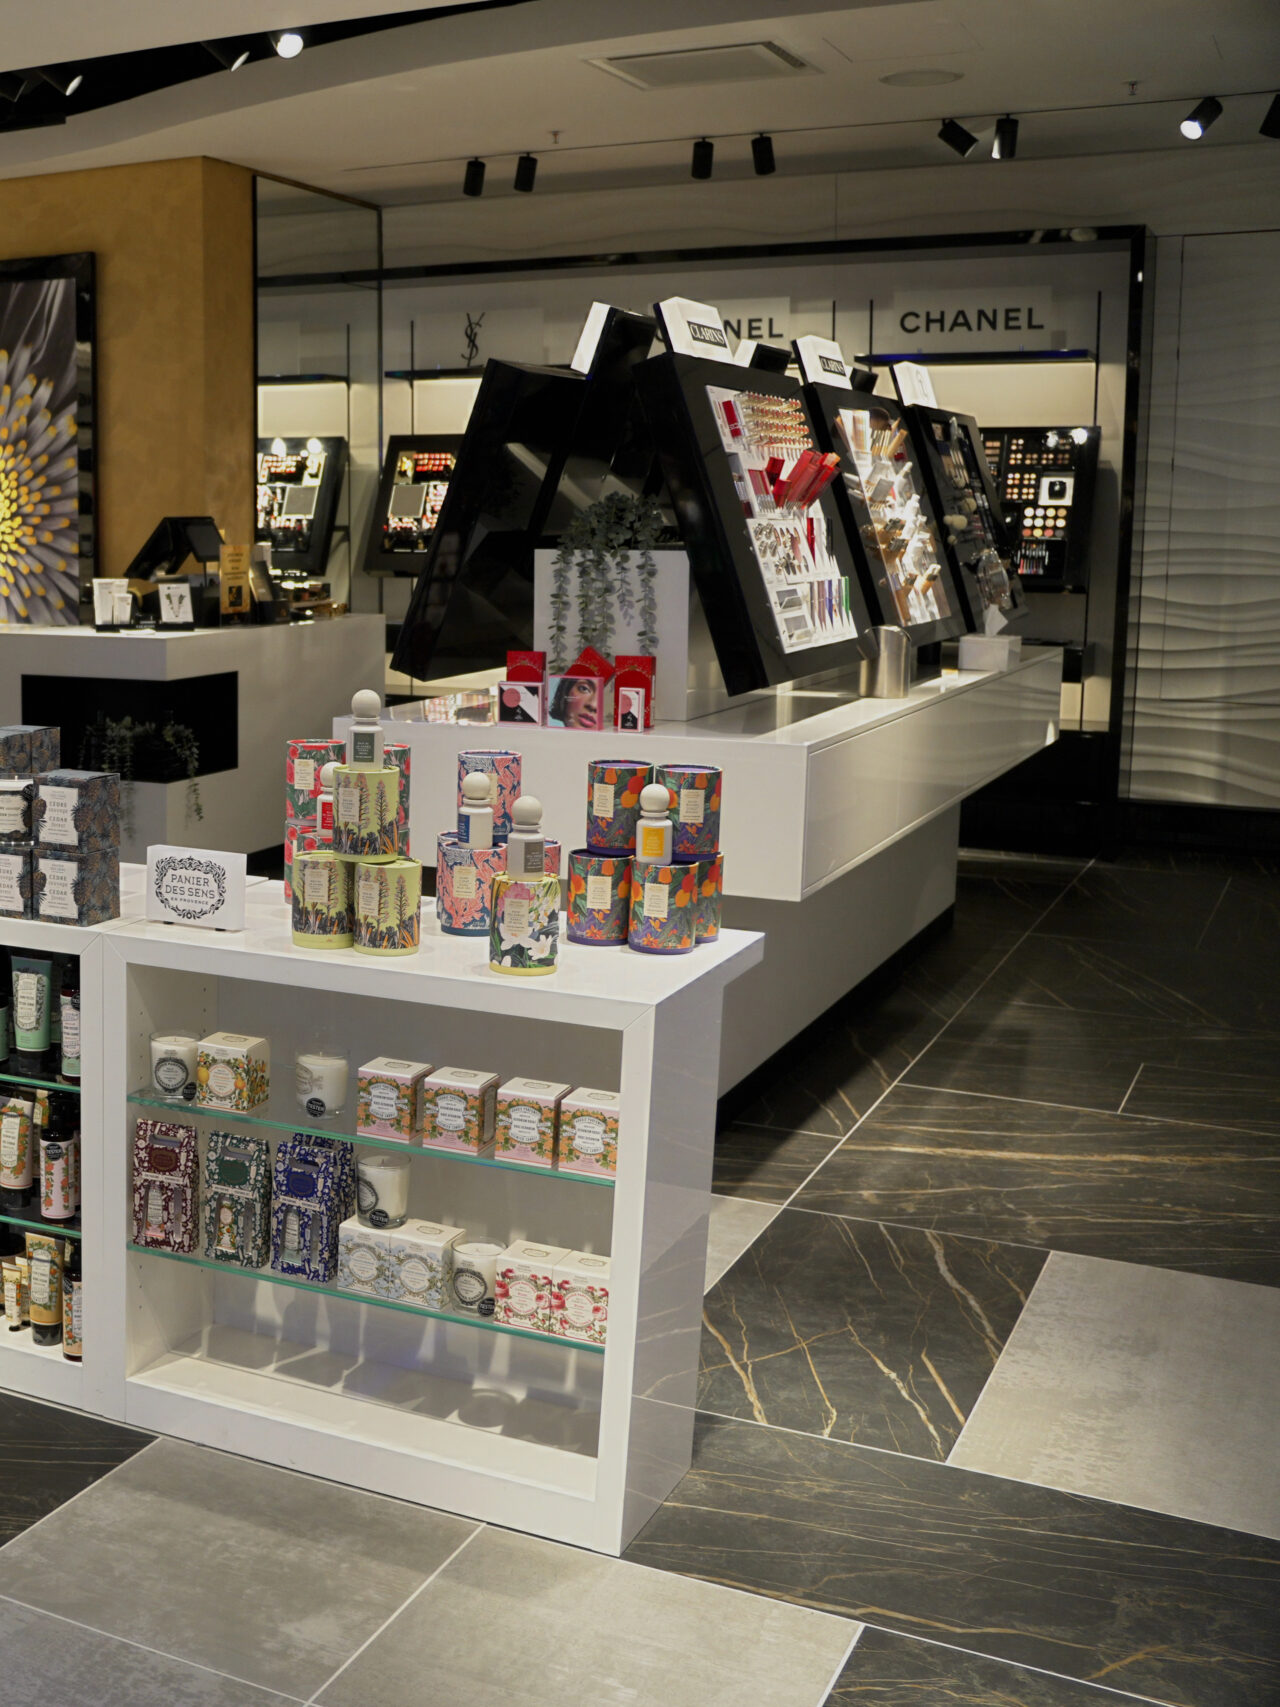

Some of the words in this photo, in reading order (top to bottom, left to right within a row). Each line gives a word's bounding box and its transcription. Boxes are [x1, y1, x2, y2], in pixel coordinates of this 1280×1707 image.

[899, 307, 1044, 334] CHANEL
[689, 323, 726, 346] CLARINS
[820, 357, 846, 375] CLARINS
[170, 873, 210, 888] PANIER
[165, 884, 186, 896] DES
[187, 887, 216, 900] SENS
[179, 897, 209, 906] PROVENCE
[307, 1103, 325, 1112] TESTER
